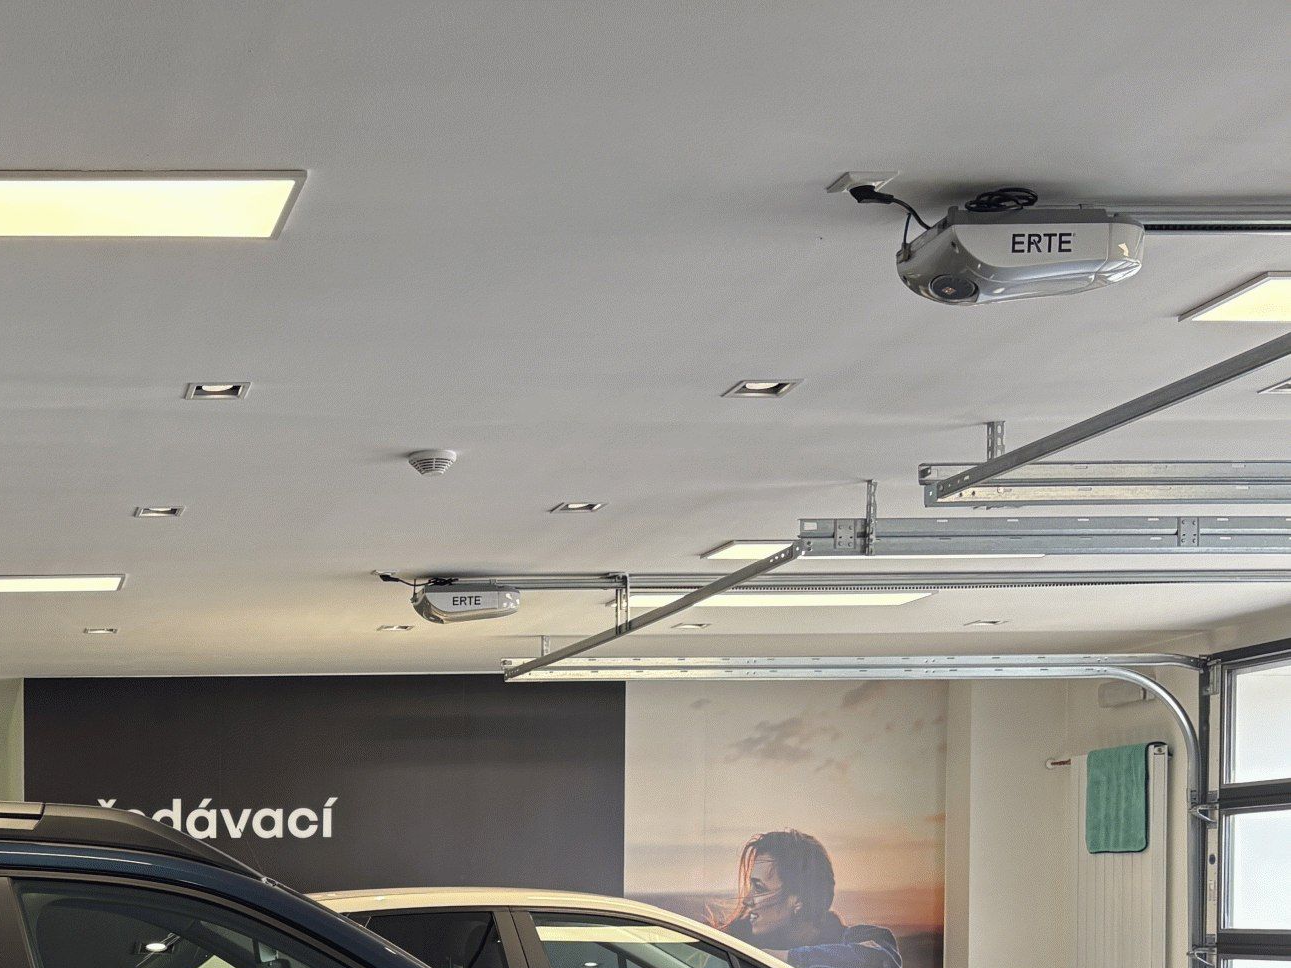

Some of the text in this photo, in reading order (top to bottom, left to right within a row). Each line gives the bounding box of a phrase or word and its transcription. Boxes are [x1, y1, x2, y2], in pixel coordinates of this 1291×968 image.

[1011, 232, 1073, 254] ERTE
[452, 595, 482, 606] ERTE
[97, 797, 339, 840] dávací
